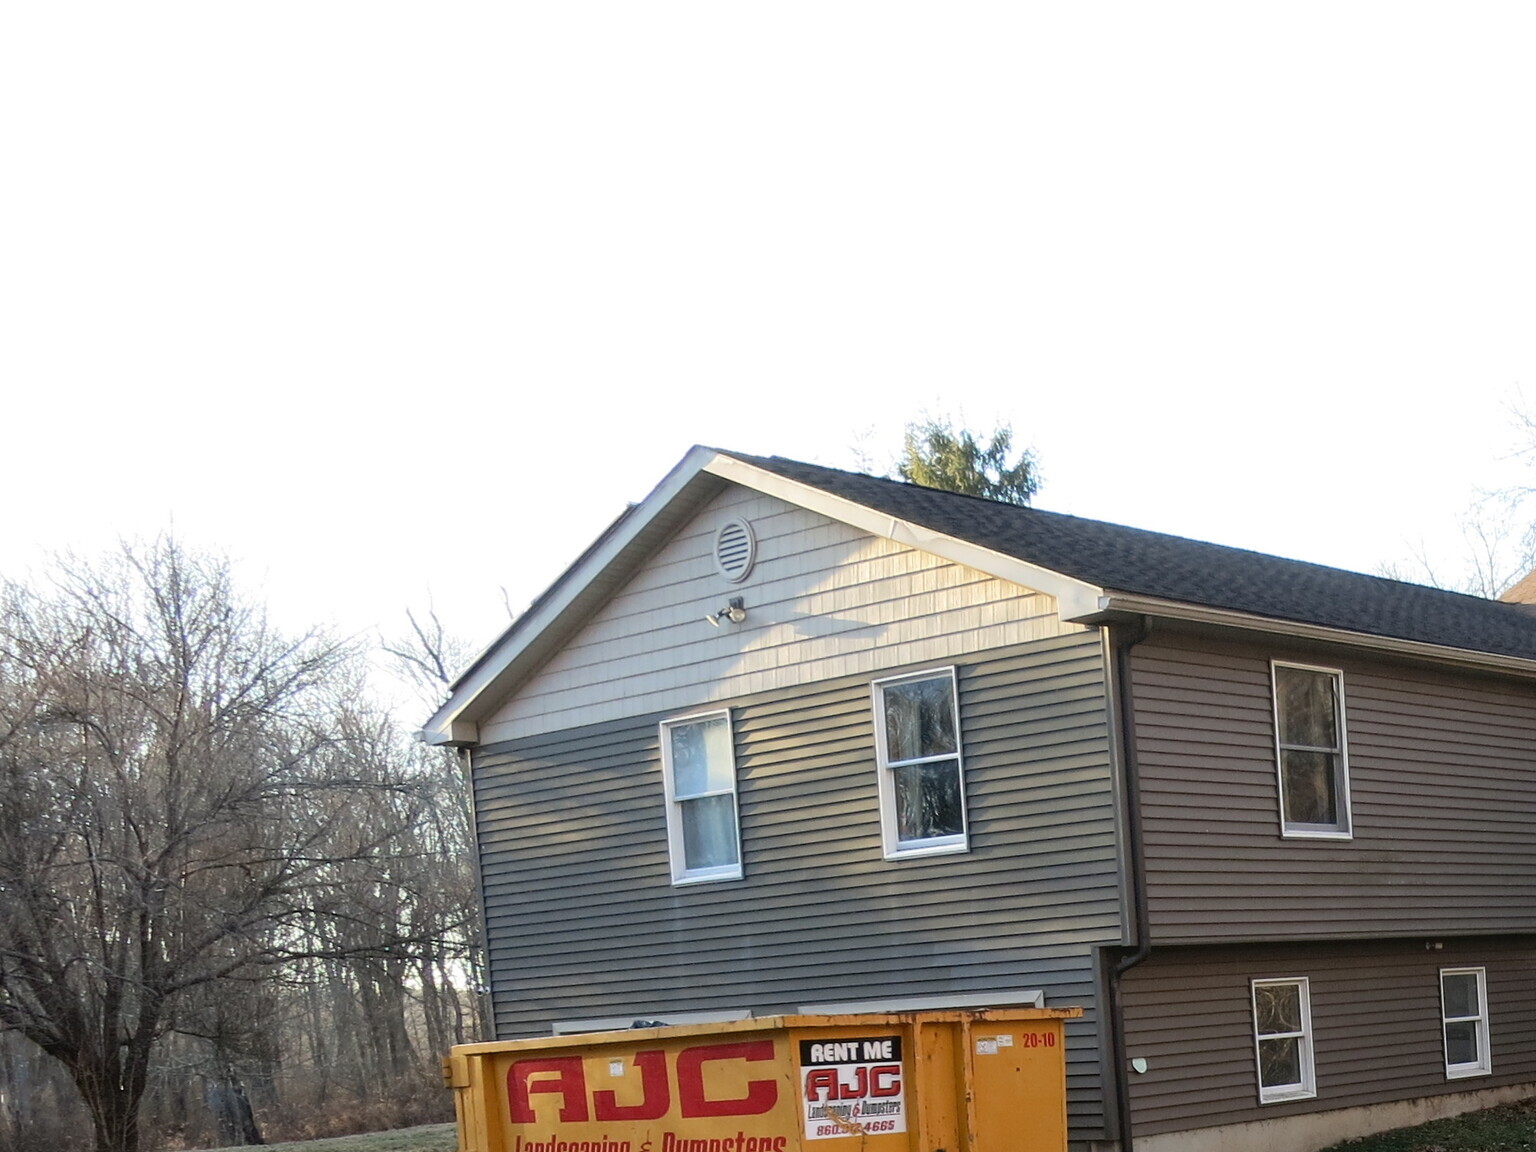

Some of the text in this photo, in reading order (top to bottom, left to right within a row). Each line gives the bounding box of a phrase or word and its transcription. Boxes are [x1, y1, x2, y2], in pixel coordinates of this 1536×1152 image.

[1022, 1032, 1055, 1048] 20-10
[811, 1041, 893, 1062] RENT ME
[506, 1040, 778, 1123] AJC
[806, 1065, 901, 1102] AJC
[862, 1101, 901, 1116] Dumpsters
